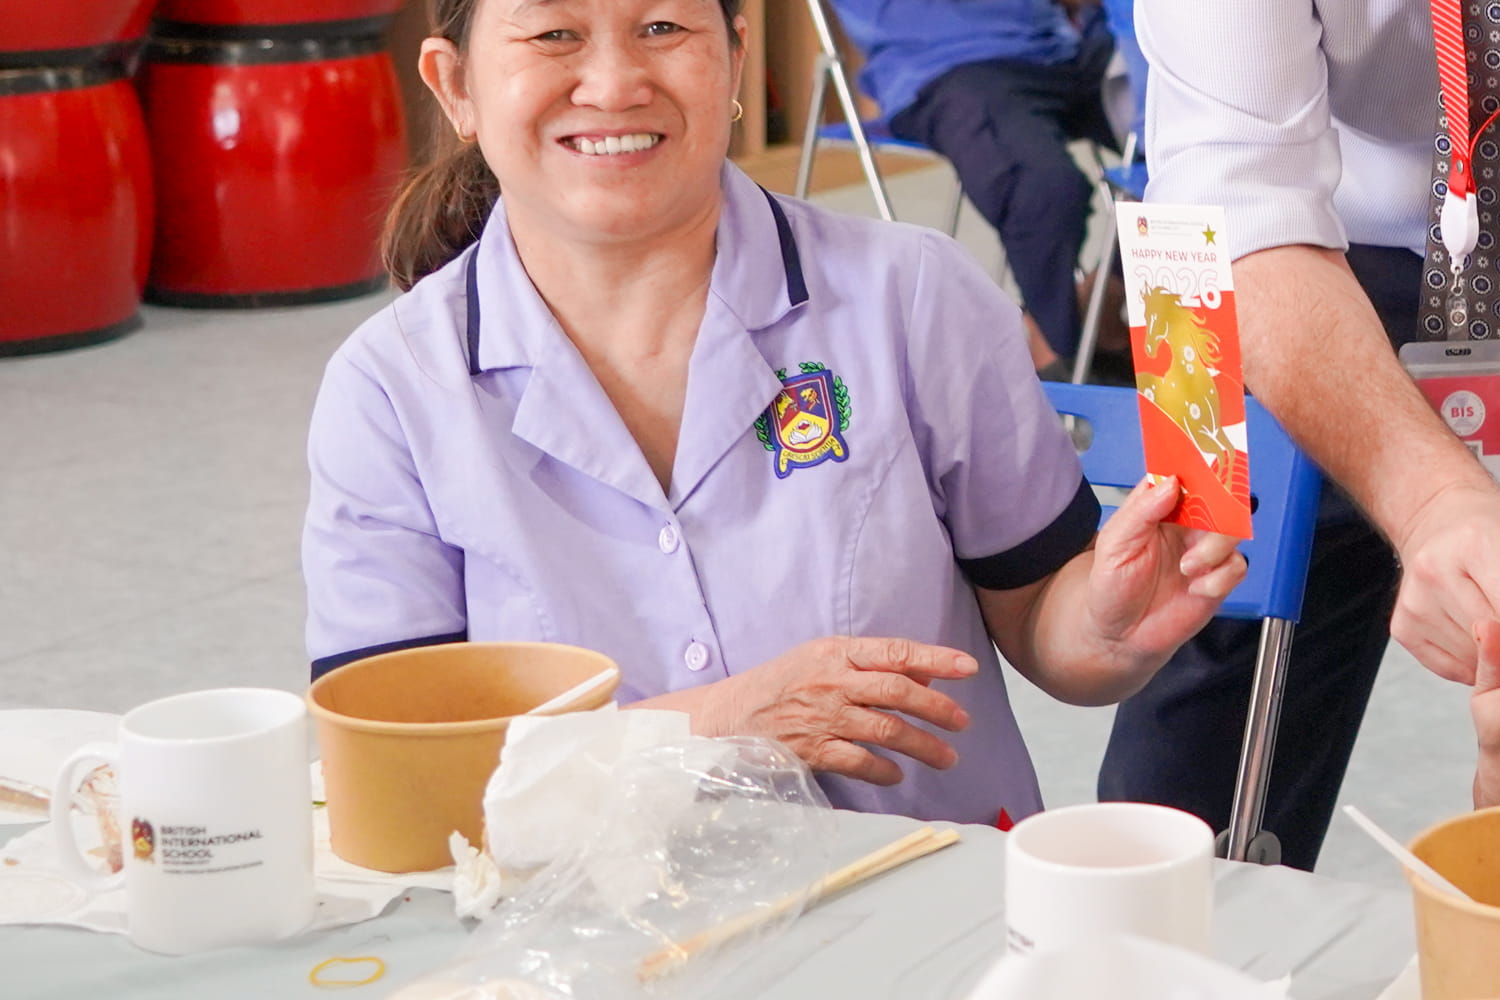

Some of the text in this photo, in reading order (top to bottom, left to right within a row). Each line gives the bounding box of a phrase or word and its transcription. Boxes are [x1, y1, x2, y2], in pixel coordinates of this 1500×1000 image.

[1131, 248, 1217, 263] HAPPY NEW YEAR
[1451, 406, 1475, 418] BIS
[160, 825, 207, 835] BRITISH
[162, 829, 263, 847] INTERNATIONAL
[162, 848, 213, 859] SCHOOL
